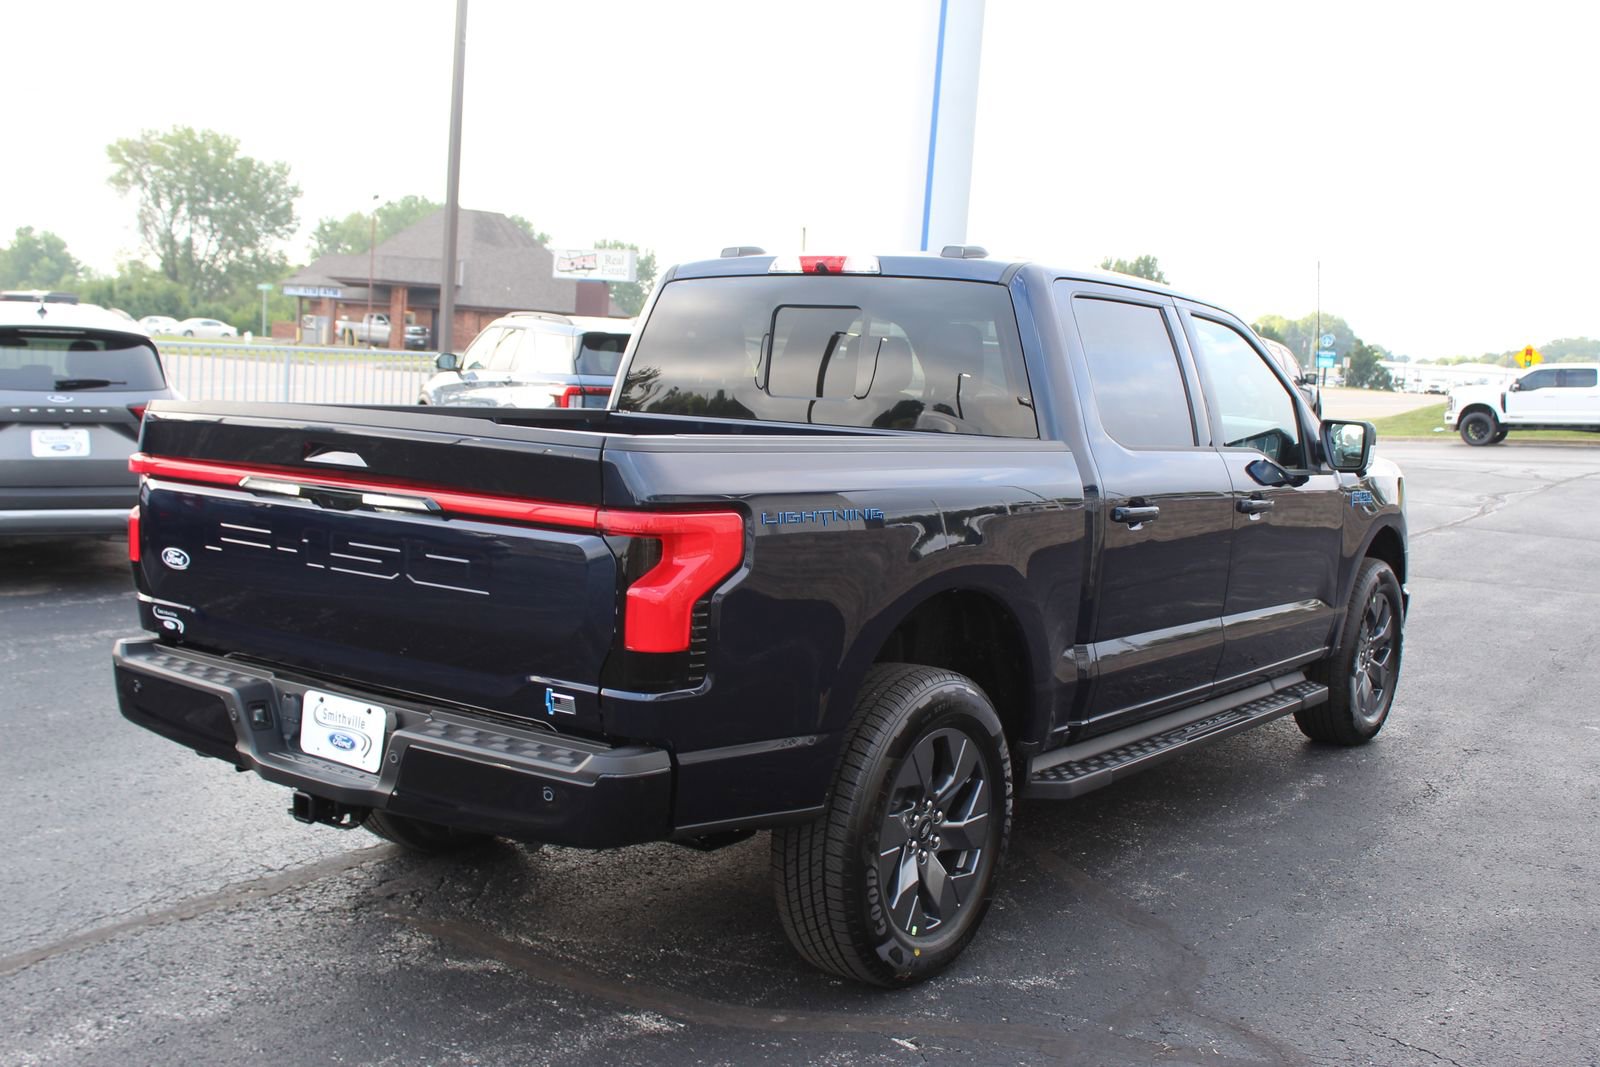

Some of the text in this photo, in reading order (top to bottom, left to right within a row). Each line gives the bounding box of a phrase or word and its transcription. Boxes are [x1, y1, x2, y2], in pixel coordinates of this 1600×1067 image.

[605, 254, 625, 265] Real
[761, 508, 884, 527] LIGHTNING
[164, 550, 187, 567] Ford
[322, 707, 366, 730] Smithville
[331, 734, 354, 750] Ford
